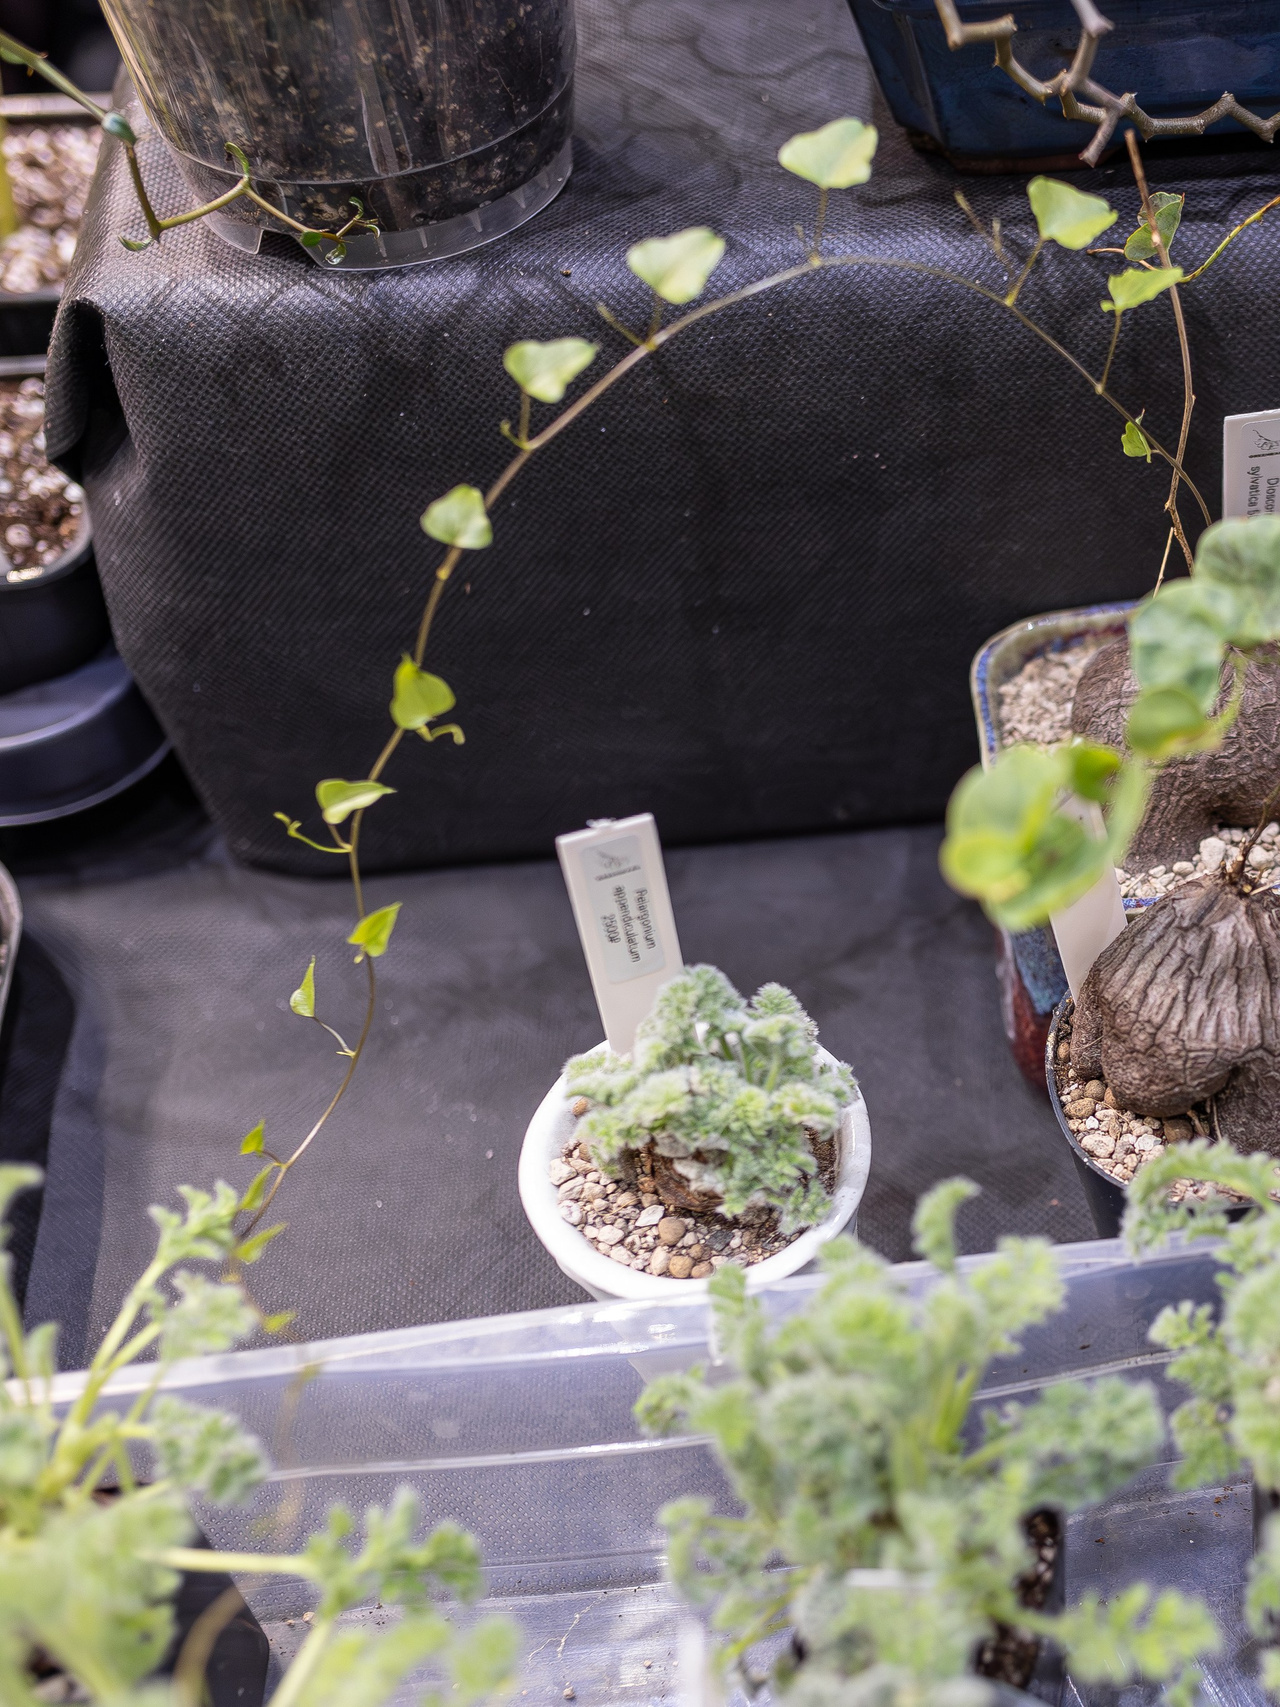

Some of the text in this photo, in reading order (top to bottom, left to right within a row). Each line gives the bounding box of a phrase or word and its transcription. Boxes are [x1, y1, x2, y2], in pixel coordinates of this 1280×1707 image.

[1247, 466, 1262, 507] sylvatica
[614, 885, 640, 962] appendiculatum
[635, 888, 656, 949] Pelargonium
